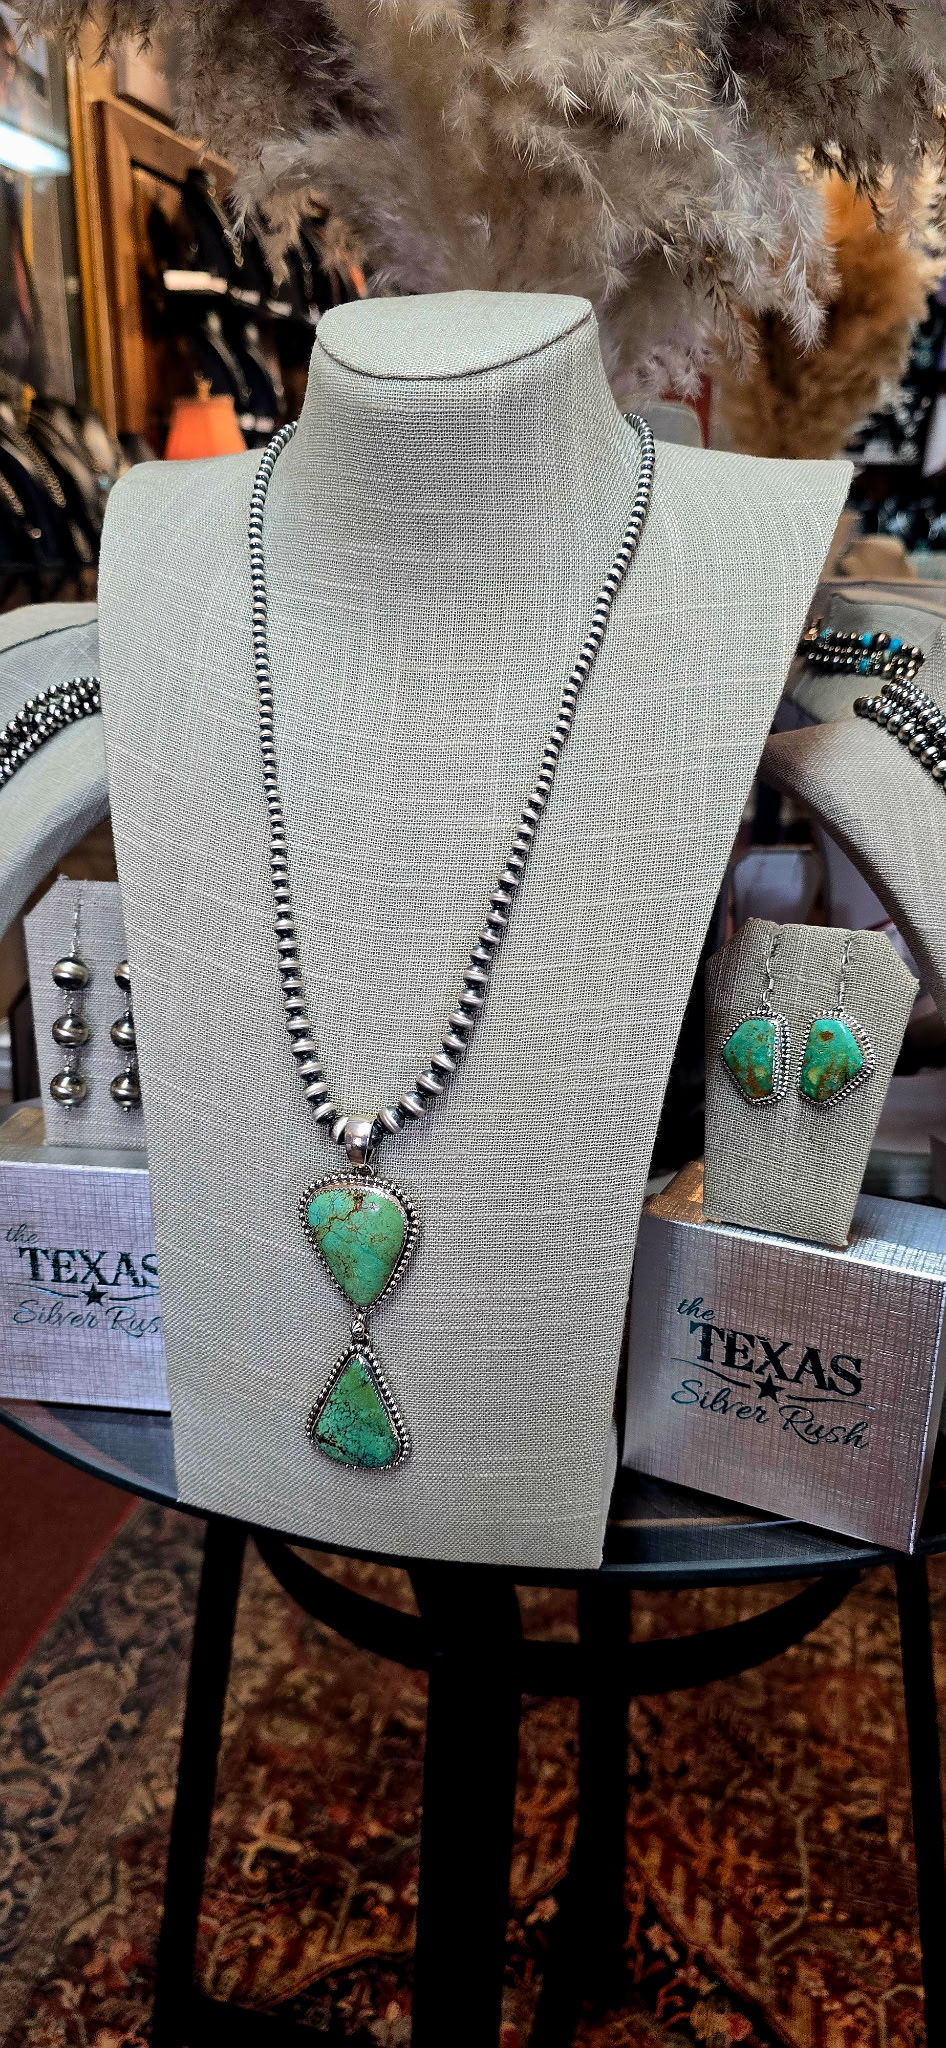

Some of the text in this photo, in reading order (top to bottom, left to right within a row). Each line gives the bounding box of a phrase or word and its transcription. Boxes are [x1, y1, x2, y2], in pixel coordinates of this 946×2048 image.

[4, 1223, 39, 1245] the
[18, 1246, 159, 1288] TEXAS
[13, 1299, 162, 1338] Silver Rus
[676, 1297, 716, 1321] the
[689, 1320, 864, 1397] TEXAS
[671, 1379, 870, 1449] Silver Rush
